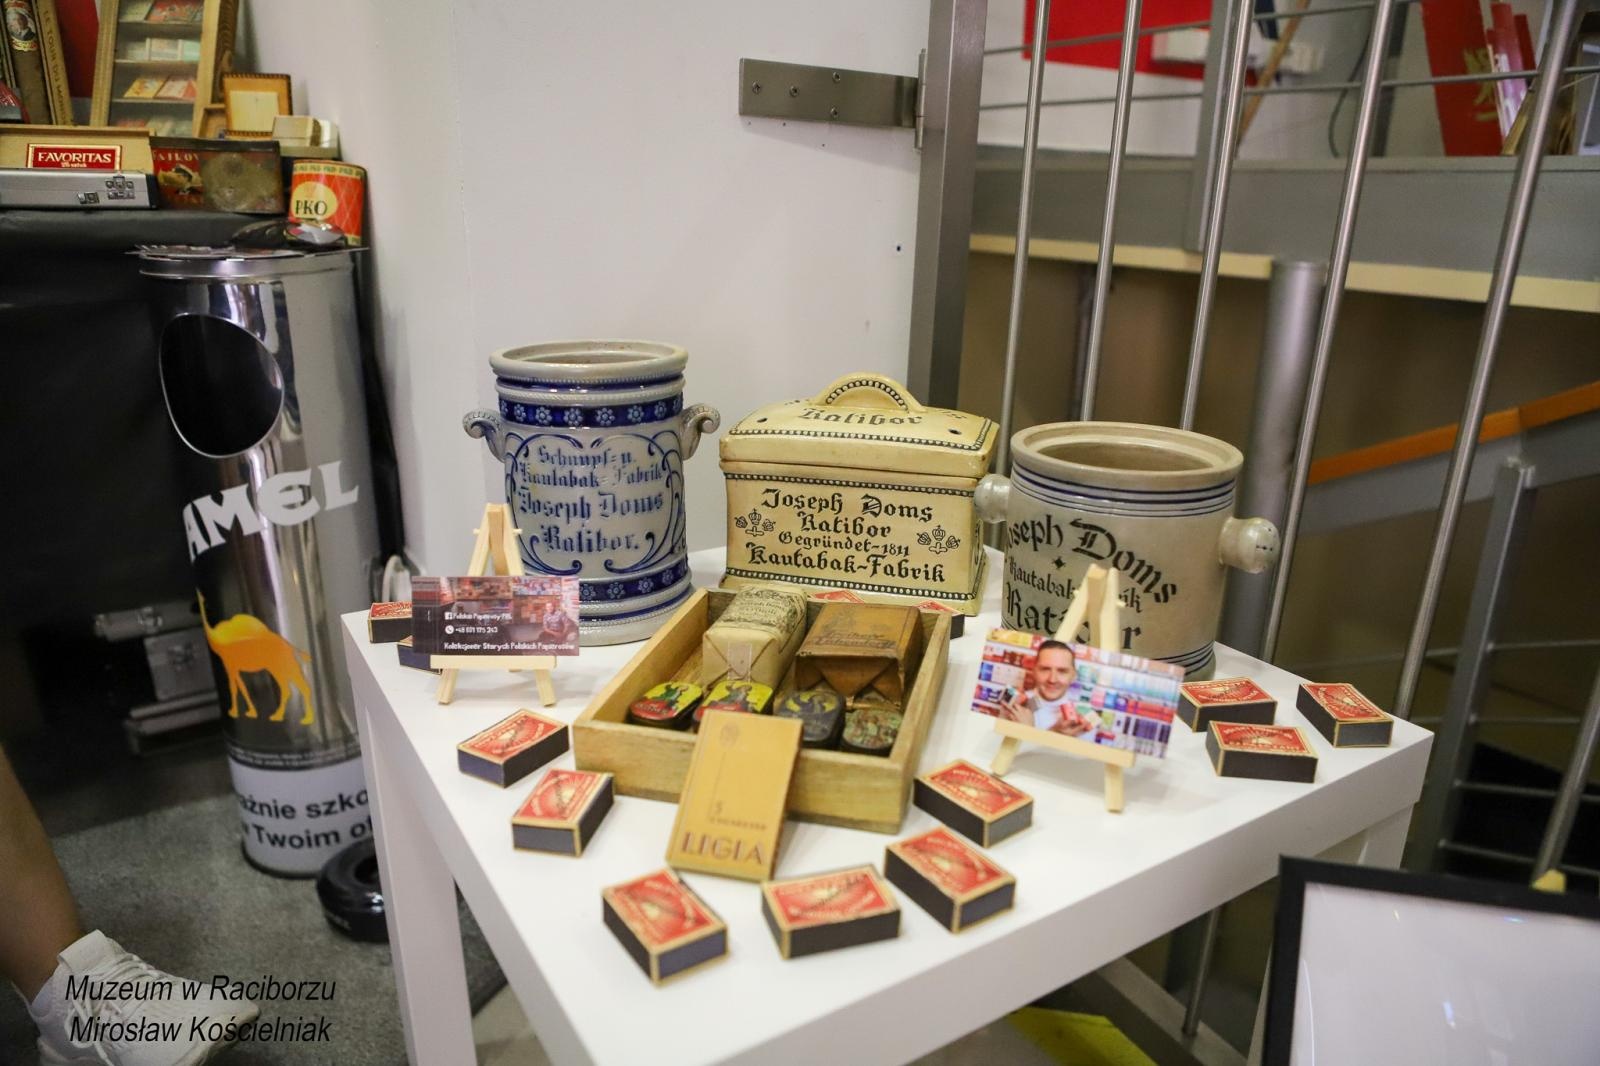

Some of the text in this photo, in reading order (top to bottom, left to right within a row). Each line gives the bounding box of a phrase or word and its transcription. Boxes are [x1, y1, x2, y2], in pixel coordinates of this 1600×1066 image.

[38, 151, 112, 164] FAVORITAS
[760, 487, 933, 523] Joseph Doms
[796, 510, 892, 538] Ratibor
[1069, 518, 1178, 604] Doms
[252, 824, 340, 849] Twoim
[681, 831, 764, 865] LIGIA
